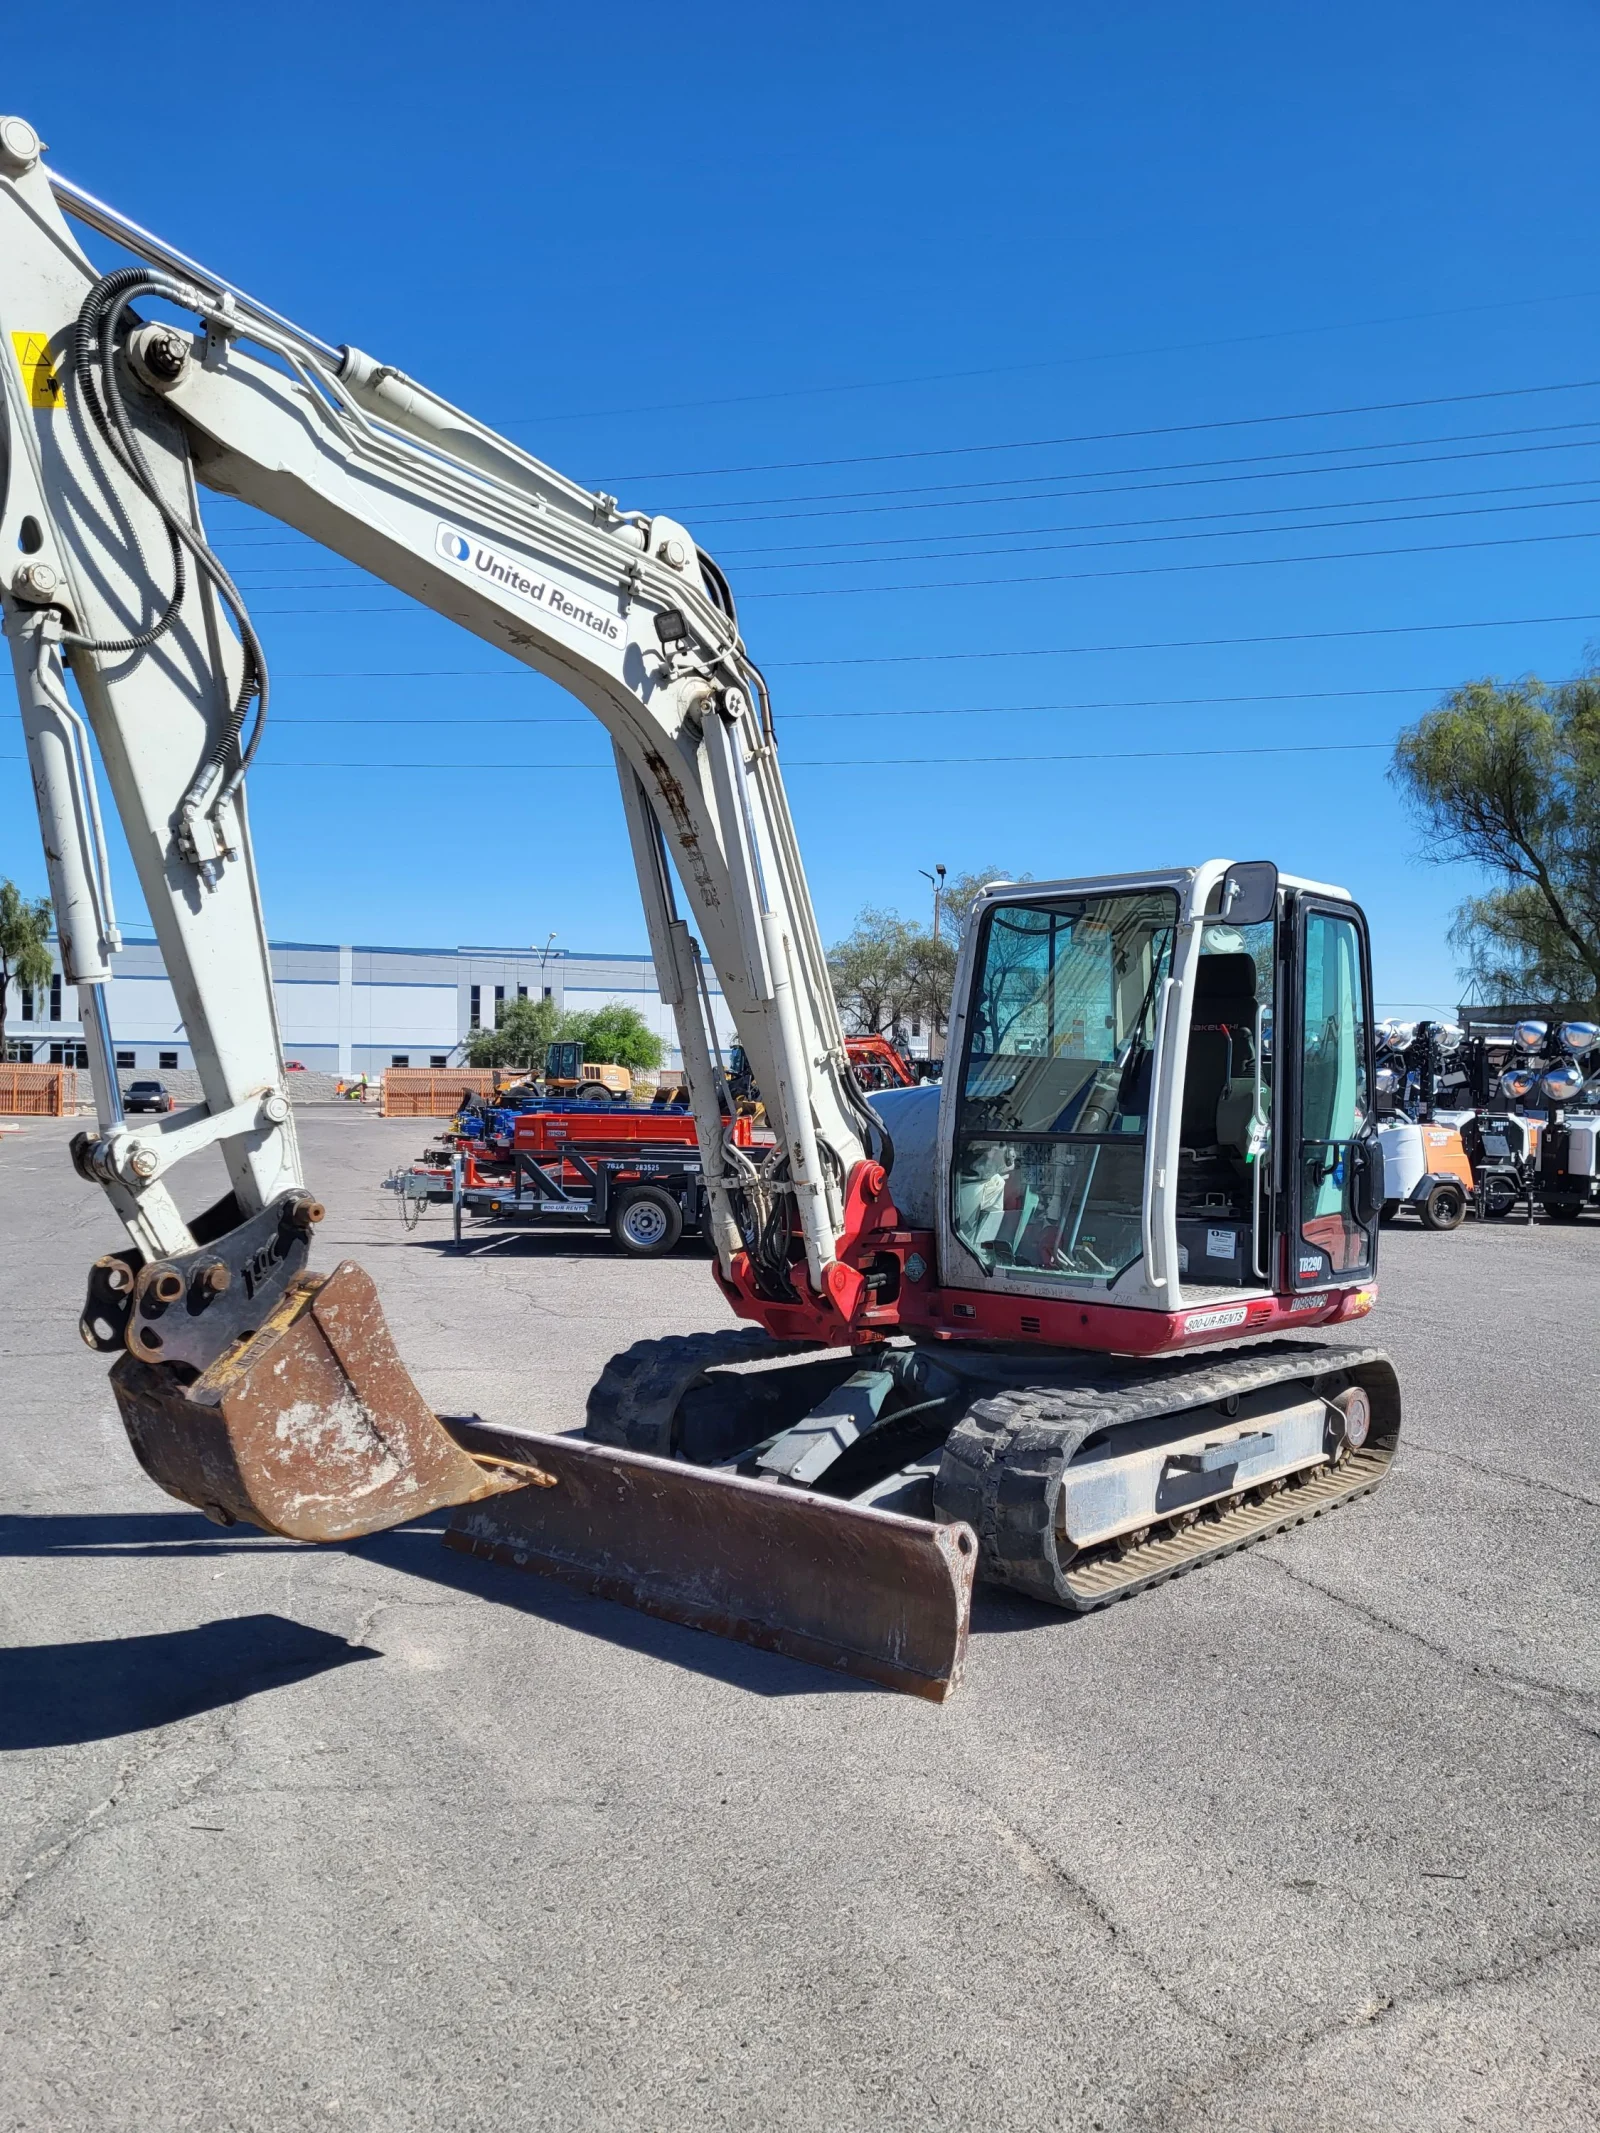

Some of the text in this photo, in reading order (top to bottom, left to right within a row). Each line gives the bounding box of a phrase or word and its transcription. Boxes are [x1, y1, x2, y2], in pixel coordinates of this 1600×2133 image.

[474, 549, 619, 640] United Rentals
[606, 1162, 625, 1170] 7614
[635, 1164, 660, 1172] 283525
[1299, 1256, 1322, 1272] TB290
